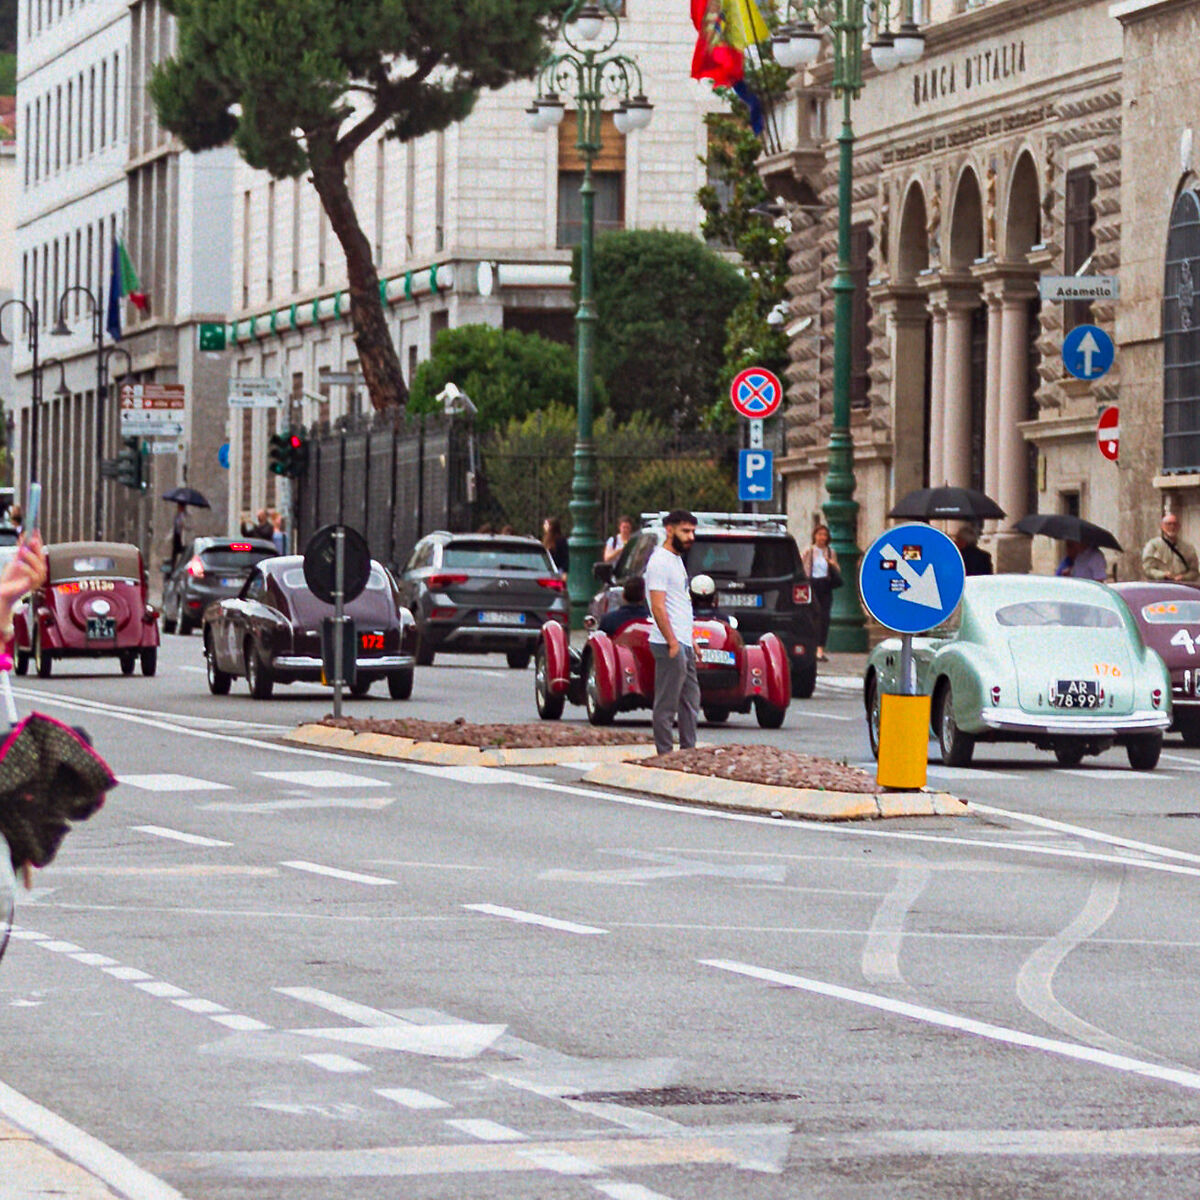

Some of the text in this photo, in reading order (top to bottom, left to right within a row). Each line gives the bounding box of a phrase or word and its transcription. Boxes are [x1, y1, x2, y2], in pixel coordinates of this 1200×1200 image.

[914, 40, 1026, 106] BANCA D'ITALIA
[1056, 287, 1111, 297] Adamello
[746, 453, 766, 479] P
[362, 634, 384, 649] 172
[1093, 663, 1122, 677] 176
[1068, 681, 1088, 694] AR
